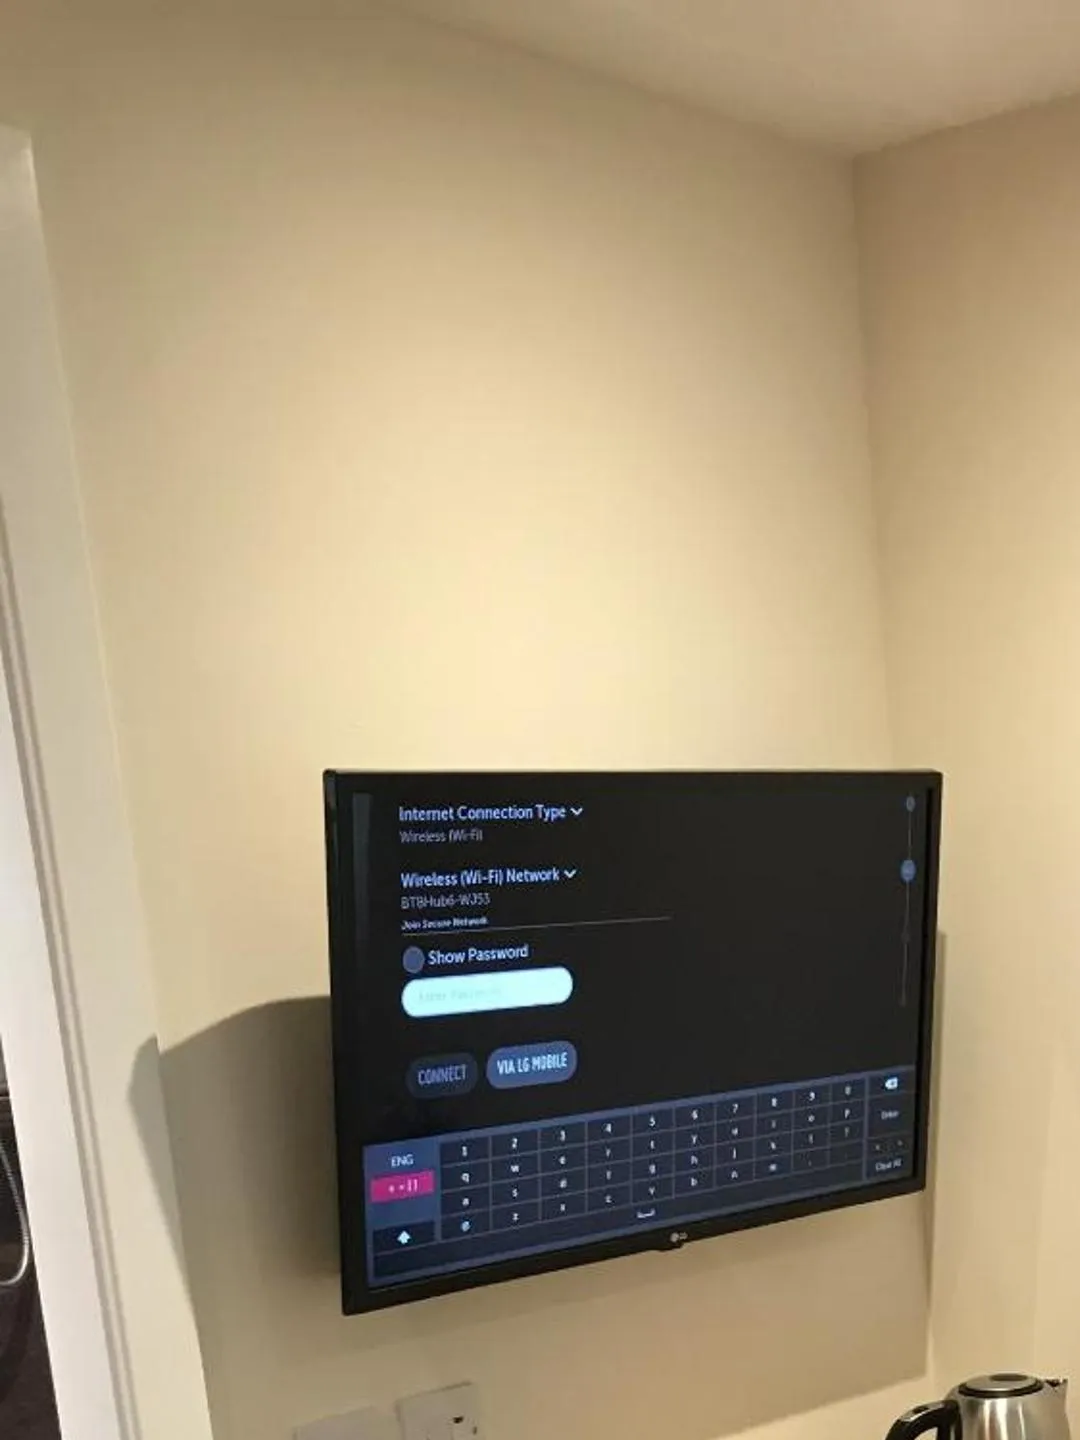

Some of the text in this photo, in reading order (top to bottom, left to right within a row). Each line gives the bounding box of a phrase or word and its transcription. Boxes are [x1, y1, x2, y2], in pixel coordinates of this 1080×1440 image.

[399, 804, 566, 821] Internet Connection Type
[400, 830, 446, 843] Wireless
[401, 868, 560, 888] Wireless (Wi-Fi) Network
[428, 944, 530, 965] Show Password
[497, 1052, 568, 1075] VIA LG MOBILE
[418, 1065, 467, 1086] CONNECT
[391, 1153, 414, 1167] ENG
